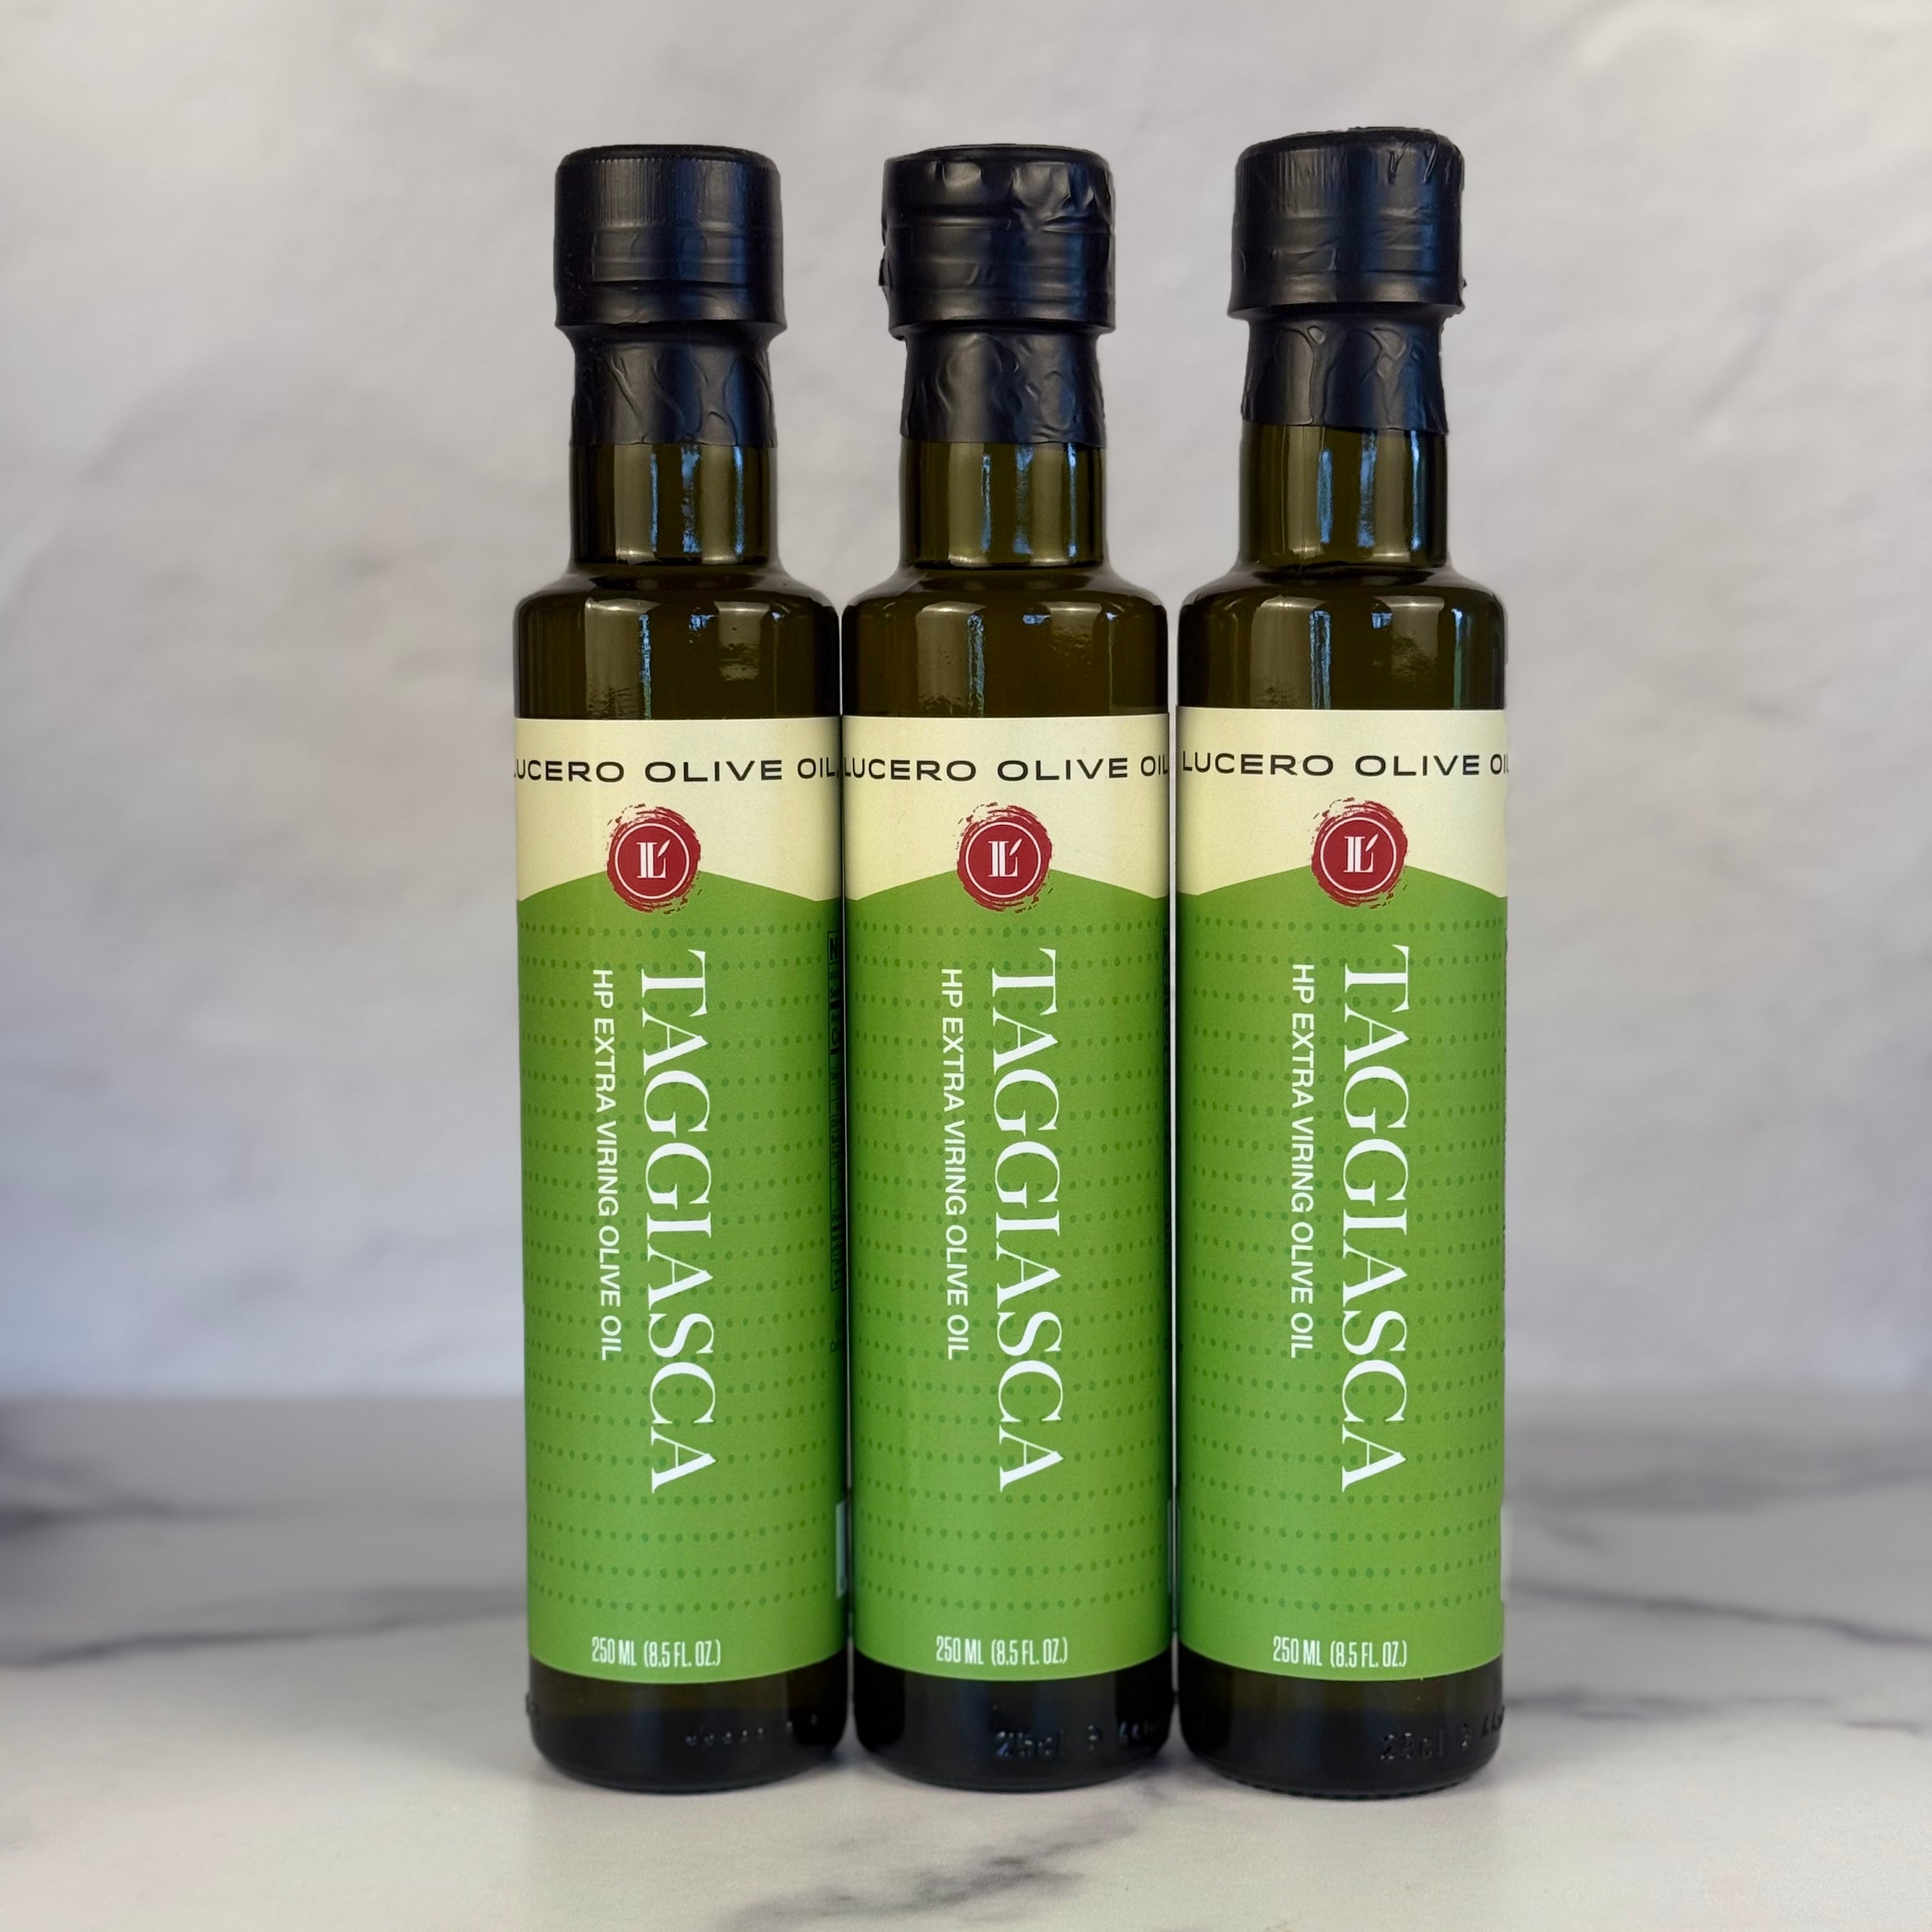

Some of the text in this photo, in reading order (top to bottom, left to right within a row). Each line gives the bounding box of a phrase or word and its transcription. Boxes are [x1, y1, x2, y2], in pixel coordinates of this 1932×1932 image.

[514, 758, 625, 783] UCERO
[645, 759, 783, 783] OLIVE
[844, 756, 977, 782] LUCERO
[997, 757, 1128, 781] OLIVE
[1182, 751, 1334, 776] LUCERO
[1355, 755, 1480, 777] OLIVE
[593, 969, 622, 1361] HP EXTRA VIRING OLIVE OIL
[641, 949, 716, 1494] TAGGIASCA
[941, 969, 969, 1360] HP EXTRA VIRING OLIVE OIL
[992, 947, 1064, 1492] TAGGIASCA
[1291, 964, 1315, 1358] HP EXTRA VIRING OLIVE OIL
[1342, 944, 1409, 1492] TAGGIASCA
[592, 1636, 721, 1667] 250 ML (8.5 FL. OZ.)
[936, 1635, 1068, 1666] 250 ML (8.5 FL. OZ.)
[1273, 1636, 1407, 1668] 250 ML (8.5 FL. OZ.)
